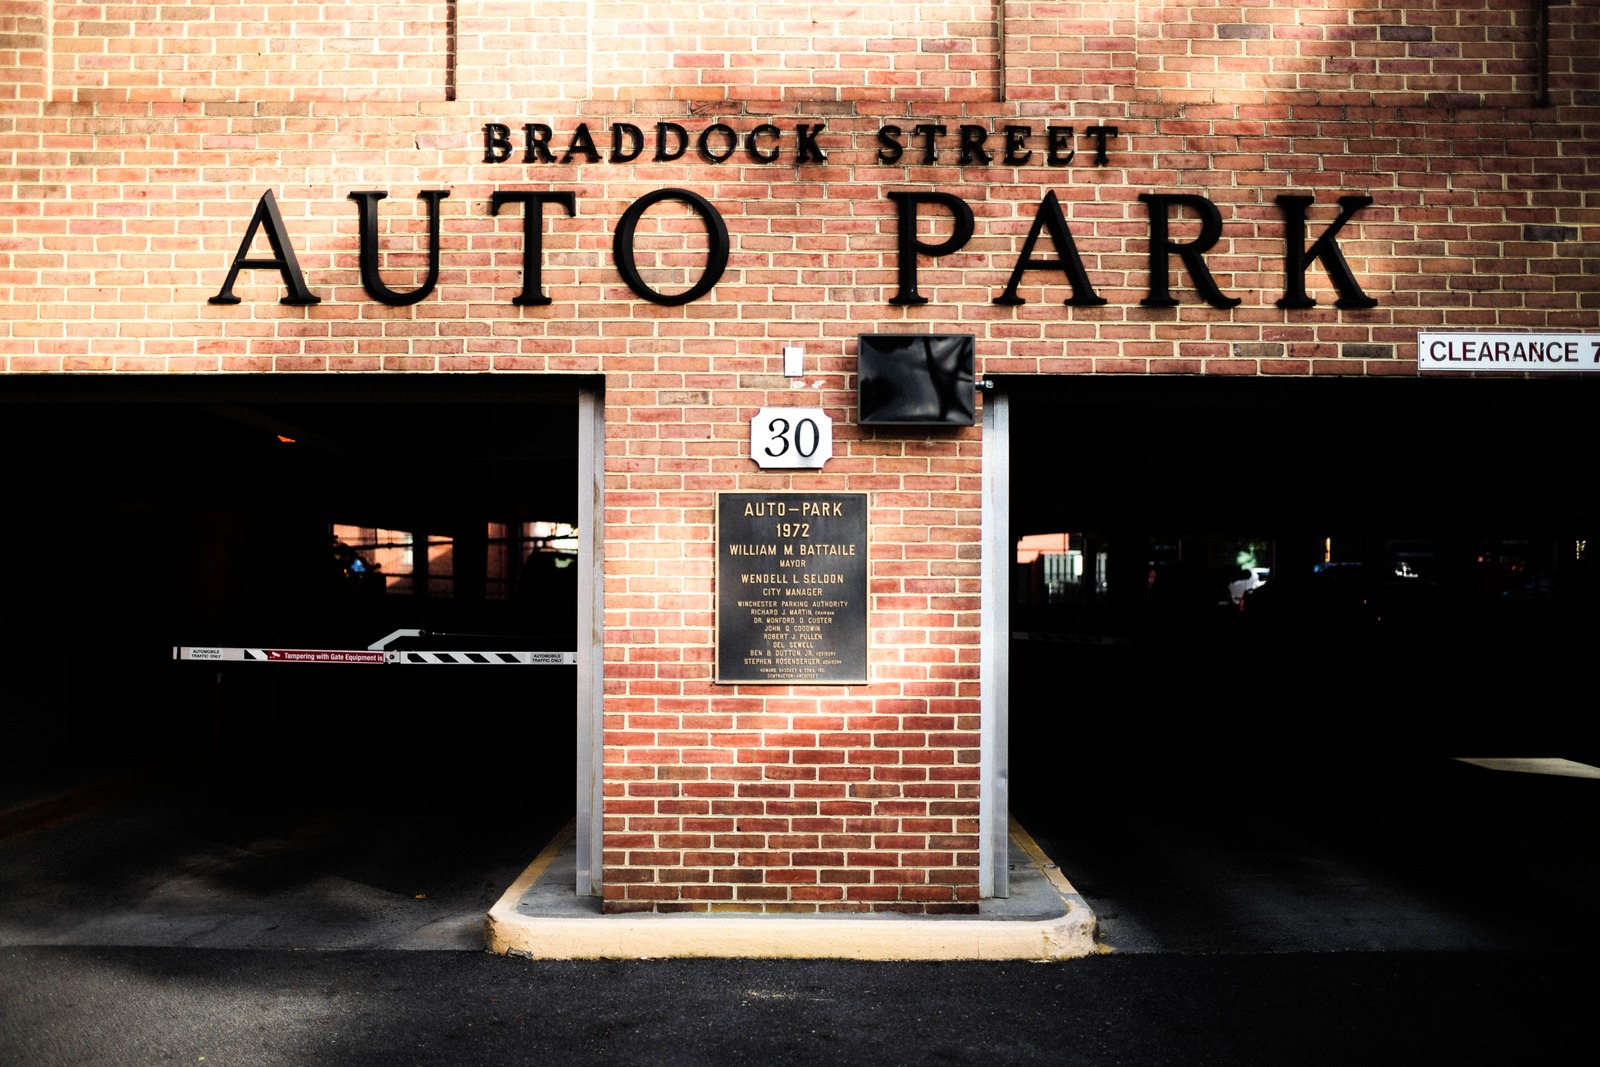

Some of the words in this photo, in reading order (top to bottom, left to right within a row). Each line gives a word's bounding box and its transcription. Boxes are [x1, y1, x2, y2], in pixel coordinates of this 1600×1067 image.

[481, 122, 827, 164] BRADDOCK
[878, 125, 1118, 166] STREET
[208, 188, 730, 306] AUTO
[887, 189, 1378, 309] PARK
[1429, 341, 1579, 363] CLEARANCE
[1590, 342, 1600, 363] 7
[764, 418, 820, 458] 30
[776, 523, 810, 538] 1972
[729, 544, 777, 556] WILLIAM
[800, 544, 855, 556] BATTAILE
[779, 559, 806, 568] MAYOR
[741, 574, 788, 584] WENDELL
[803, 574, 844, 584] SELDON
[762, 588, 781, 596] CITY
[785, 588, 823, 596] MANAGER
[773, 641, 785, 649] DEL
[789, 641, 814, 649] SEWELL
[284, 652, 315, 661] Tampering
[316, 652, 330, 660] with
[345, 653, 377, 662] Equipment
[750, 649, 763, 657] BEN
[775, 649, 801, 657] DUTTON
